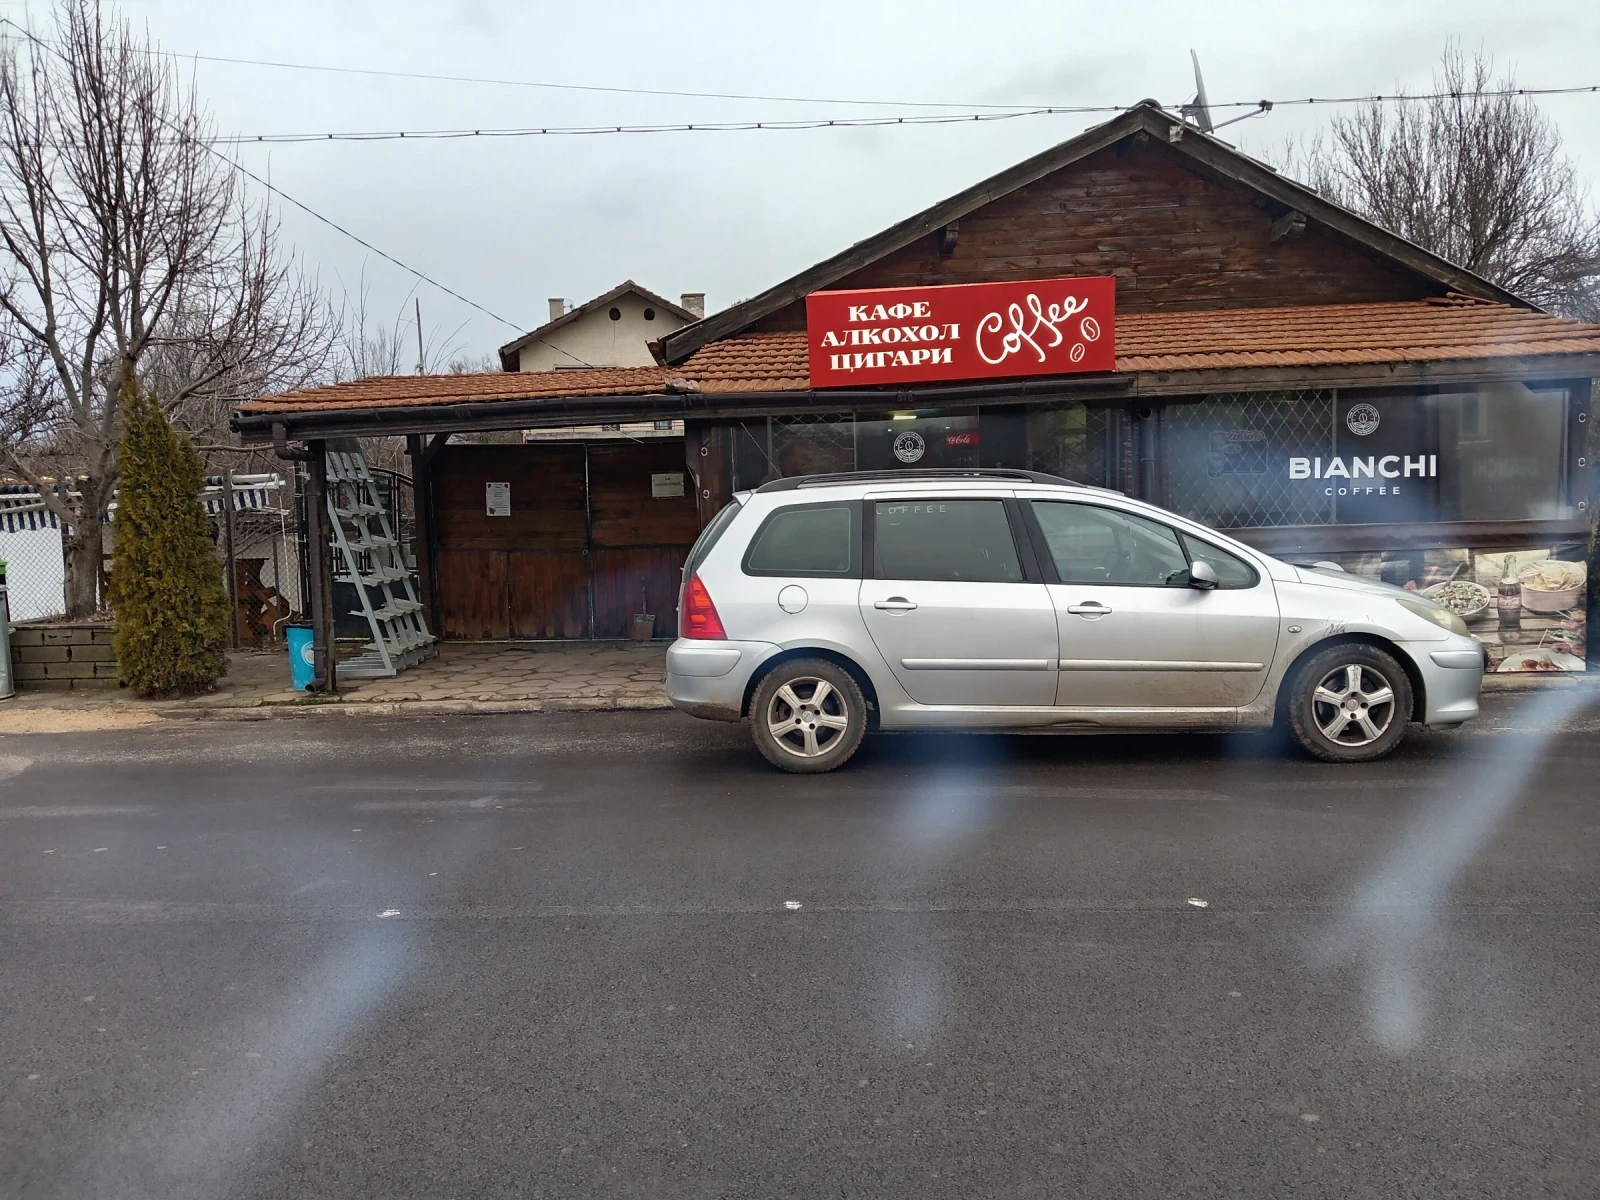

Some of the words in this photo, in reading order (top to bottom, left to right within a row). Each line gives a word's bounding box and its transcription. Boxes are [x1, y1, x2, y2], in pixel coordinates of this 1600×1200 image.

[847, 301, 932, 322] КАФЕ
[820, 323, 961, 348] АЛКОХОЛ
[975, 293, 1089, 365] Coffee
[829, 347, 953, 373] ЦИГАРИ
[1289, 454, 1437, 480] BIANCHI
[1324, 485, 1402, 497] COFFEE
